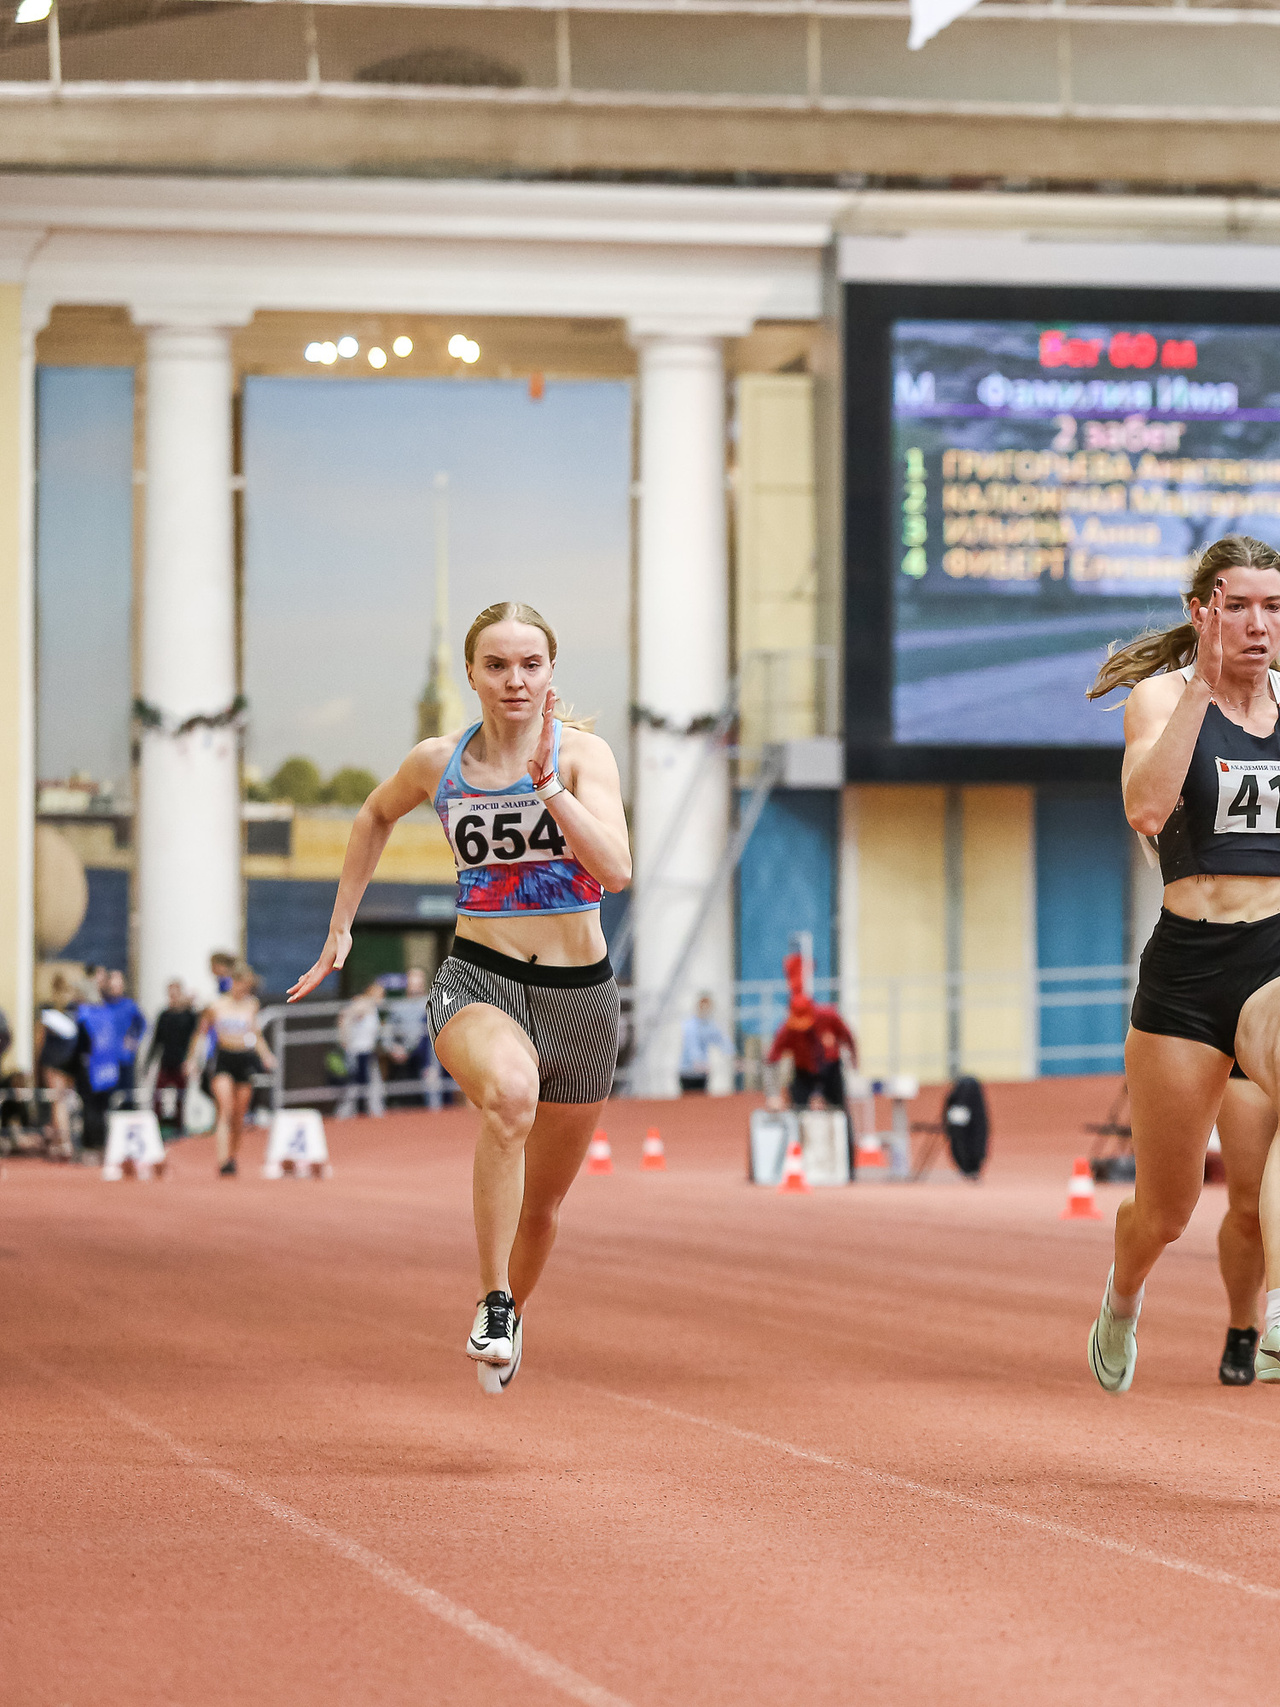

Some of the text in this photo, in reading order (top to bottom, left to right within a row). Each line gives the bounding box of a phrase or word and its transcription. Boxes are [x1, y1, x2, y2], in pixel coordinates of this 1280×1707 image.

[1109, 332, 1157, 369] 60
[977, 374, 1152, 411] Фамилия
[1156, 376, 1238, 413] Имя
[1053, 414, 1186, 452] 2 забег
[905, 448, 927, 481] 1
[943, 449, 1133, 483] ГРИГОРЬЕВА
[902, 481, 926, 513] 2
[902, 514, 927, 547] 3
[1081, 516, 1161, 547] Анна
[902, 547, 927, 579] 4
[1231, 764, 1269, 772] АКАДЕМИЯ
[470, 802, 499, 812] ДЮСШ
[455, 809, 567, 866] 654
